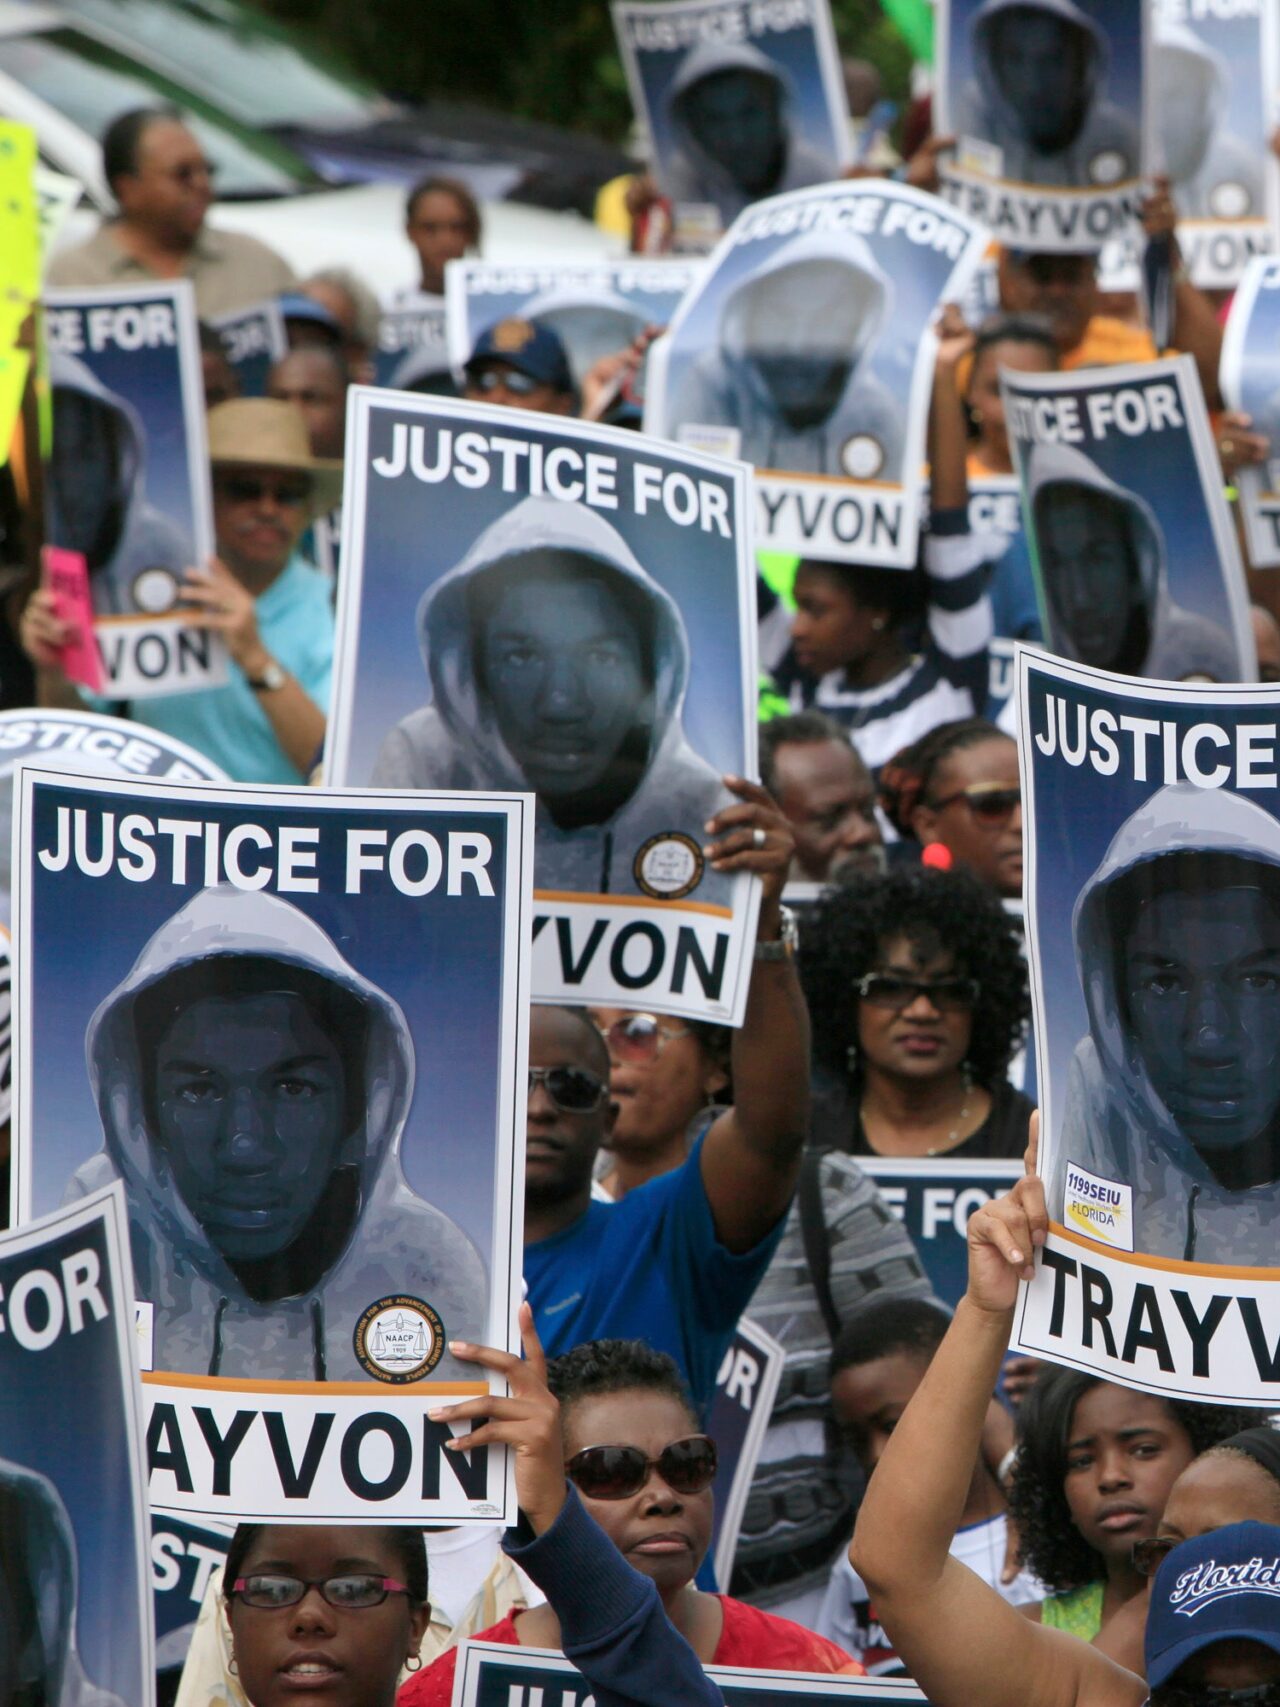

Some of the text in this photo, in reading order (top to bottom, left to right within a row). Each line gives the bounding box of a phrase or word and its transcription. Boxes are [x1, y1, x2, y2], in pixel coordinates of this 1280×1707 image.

[734, 195, 884, 246] JUSTICE
[881, 200, 969, 262] FOR
[88, 303, 176, 351] FOR
[1087, 384, 1184, 441] FOR
[371, 424, 732, 539] JUSTICE FOR
[1035, 693, 1277, 789] JUSTICE
[37, 806, 495, 897] JUSTICE FOR
[1068, 1172, 1121, 1206] 1199SEIU
[1071, 1200, 1115, 1227] FLORIDA
[0, 1248, 109, 1351] OR
[385, 1334, 414, 1342] NAACP
[146, 1402, 488, 1501] AYVON
